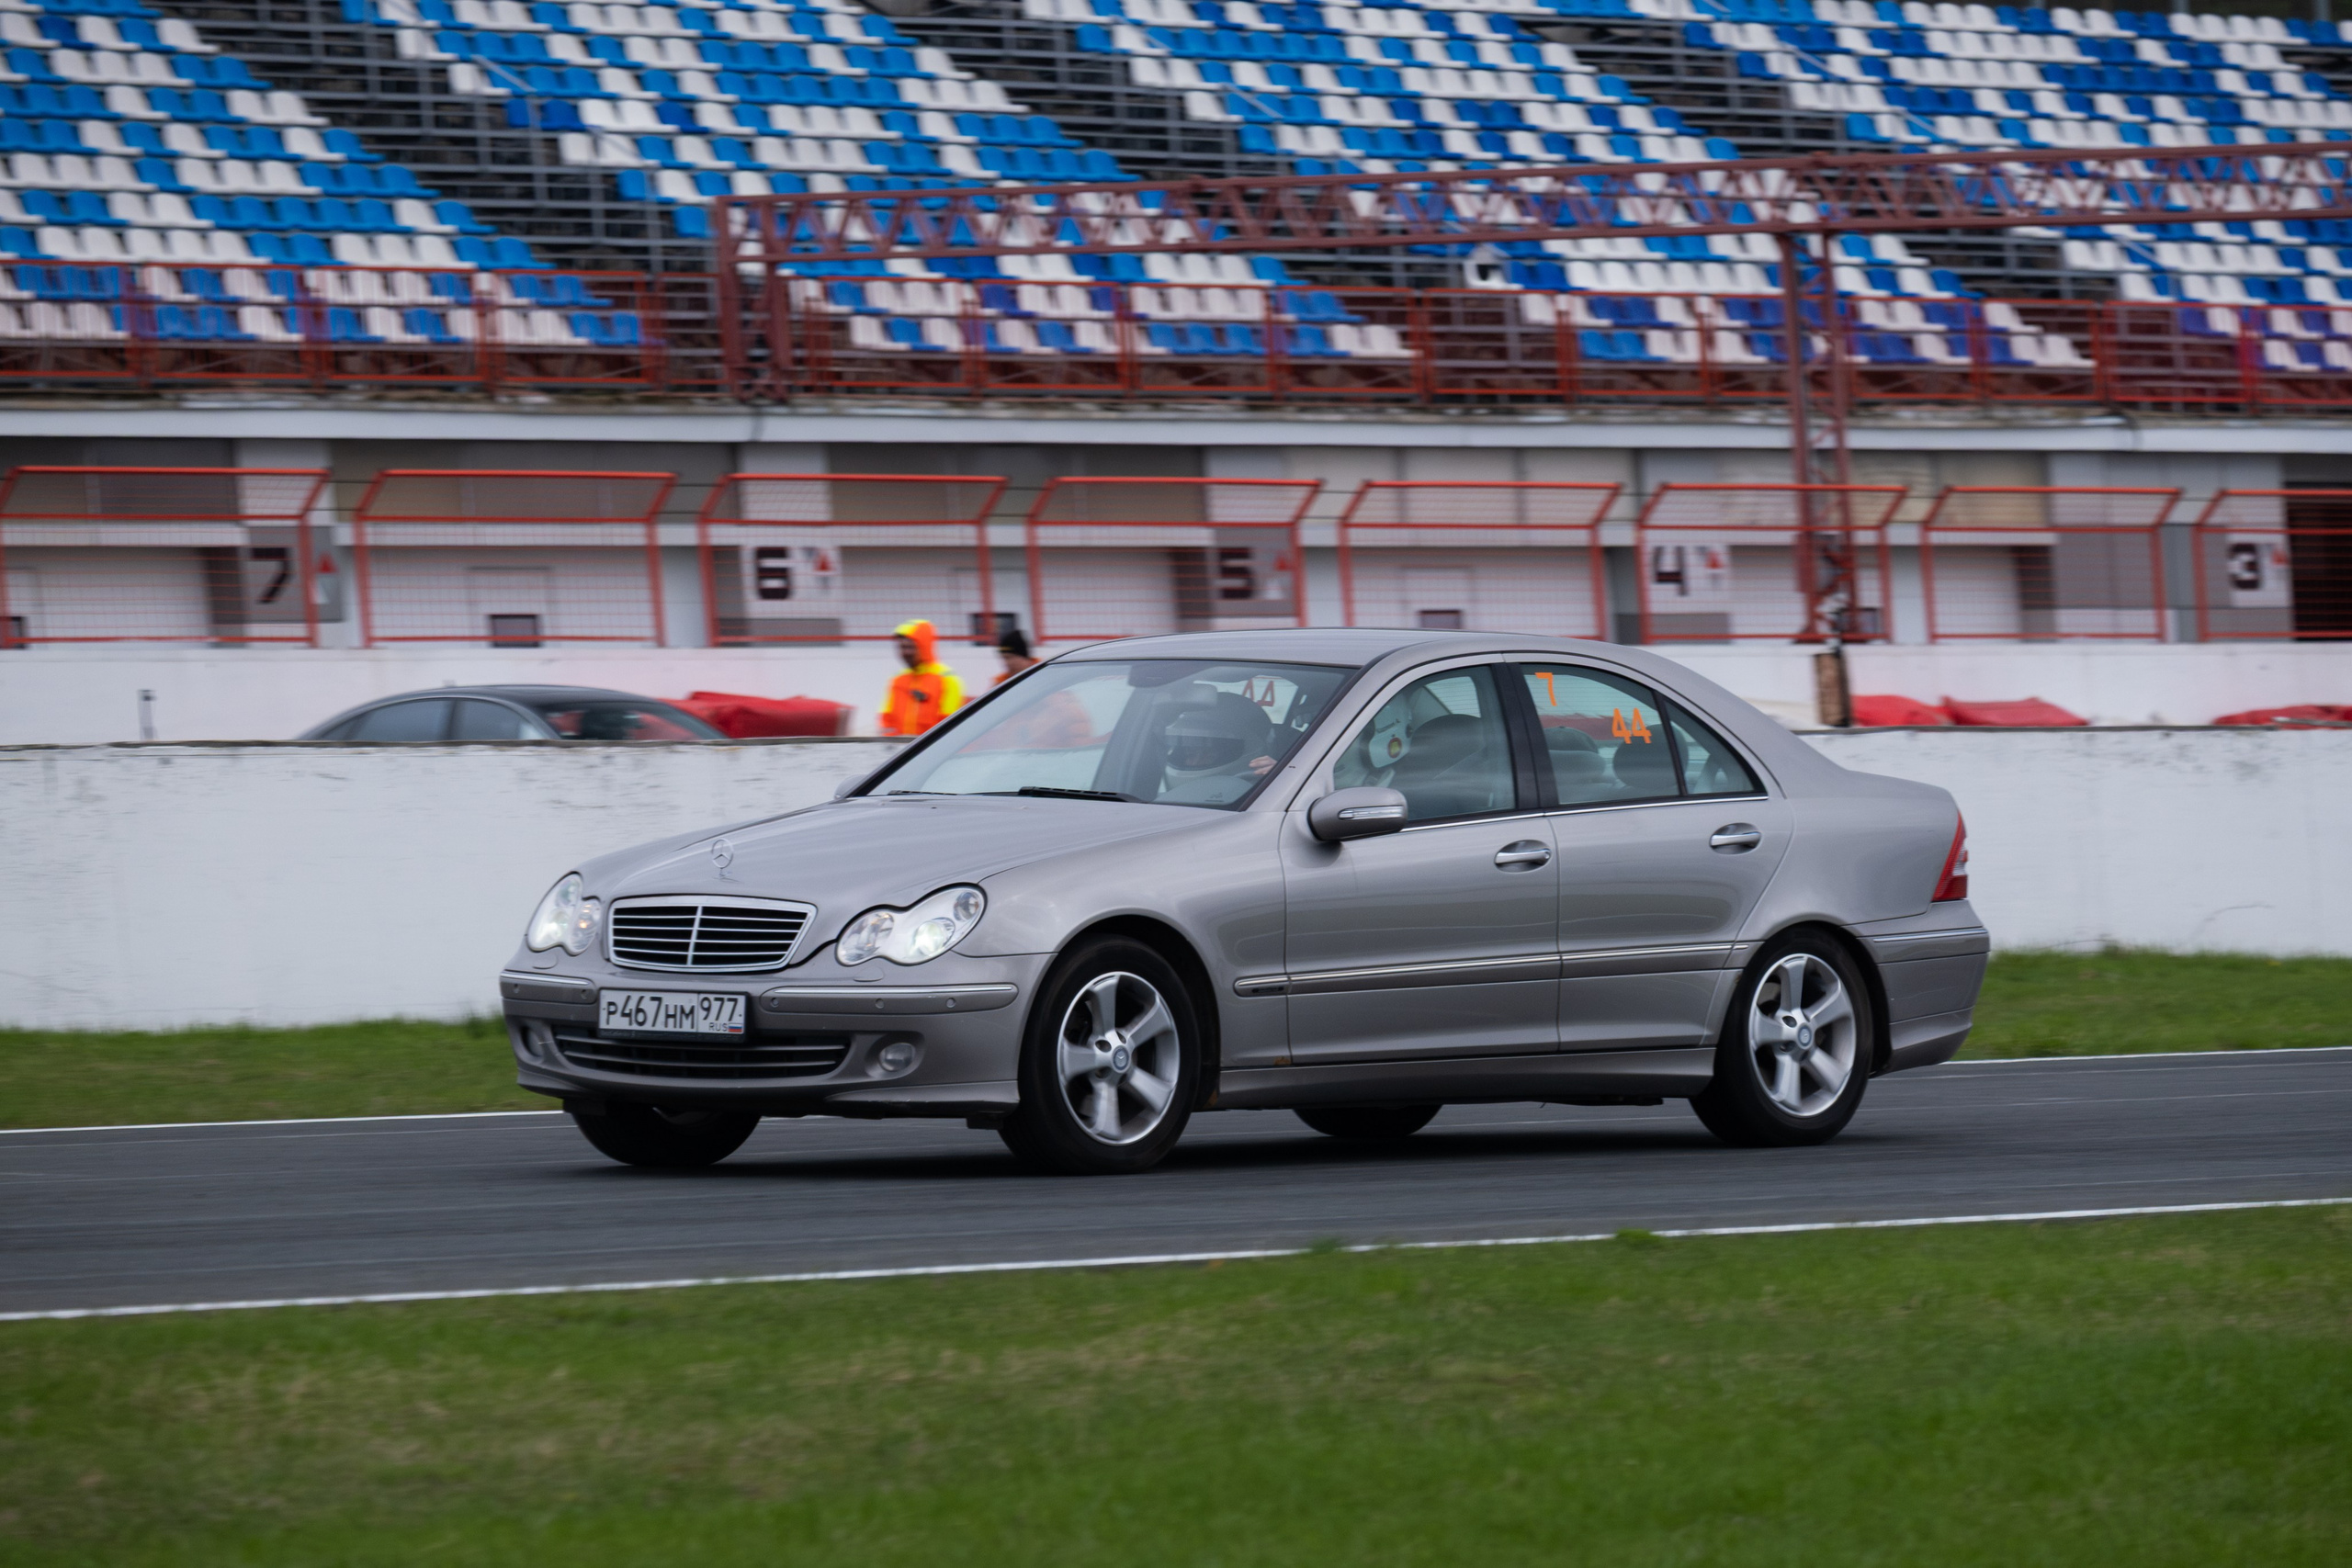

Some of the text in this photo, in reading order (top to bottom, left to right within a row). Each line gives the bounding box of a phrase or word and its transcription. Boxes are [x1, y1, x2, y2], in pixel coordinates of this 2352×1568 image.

[251, 547, 293, 604] 7
[755, 547, 793, 600] 6
[1218, 547, 1255, 600] 5
[1653, 546, 1689, 596] 4
[2228, 544, 2263, 590] 3
[1611, 707, 1652, 744] 44
[708, 1022, 728, 1032] RUS
